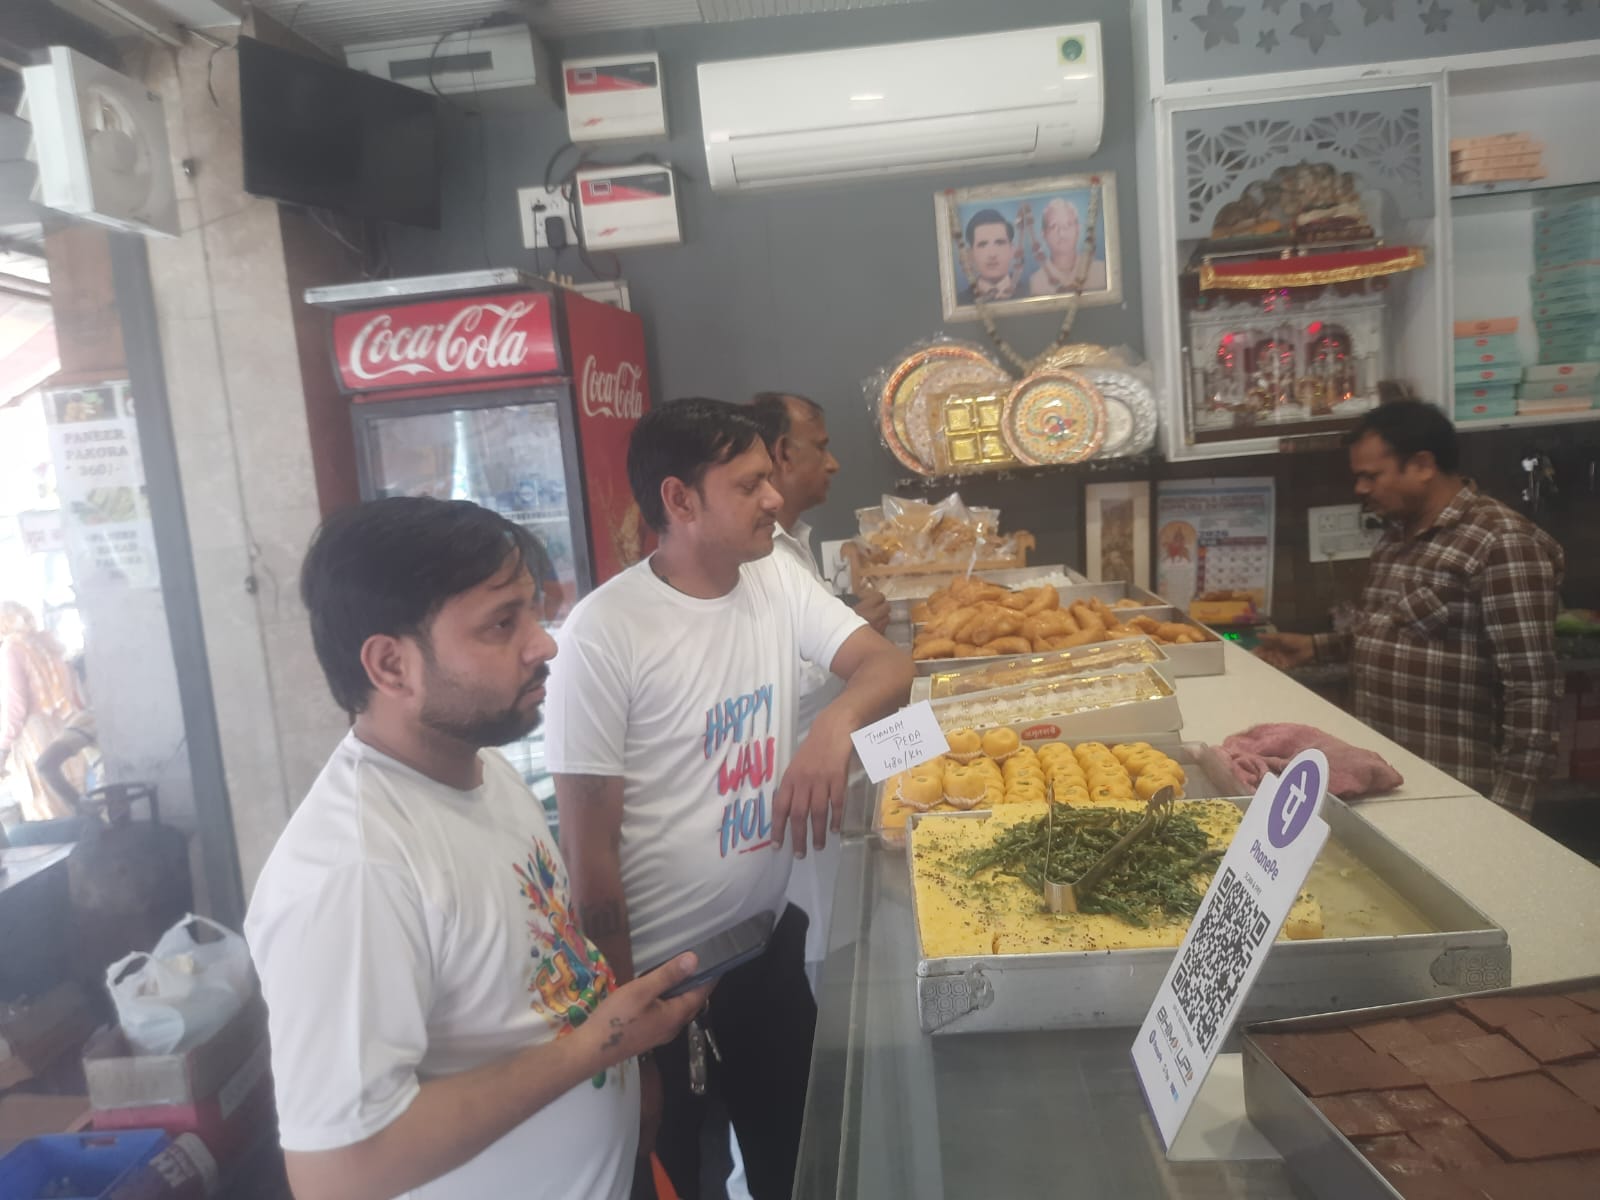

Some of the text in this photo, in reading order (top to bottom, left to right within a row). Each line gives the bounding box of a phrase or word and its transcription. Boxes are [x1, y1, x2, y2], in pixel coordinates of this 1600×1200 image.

[352, 301, 536, 379] Coca-Cola
[582, 355, 642, 419] Coca-Cola
[65, 446, 129, 460] PAKORA
[704, 684, 773, 760] HAPPY
[893, 729, 921, 750] PEDA
[717, 788, 776, 858] HOL
[1250, 830, 1279, 881] PhonePe
[1157, 1006, 1178, 1046] BHIM
[1177, 1048, 1193, 1079] UPI
